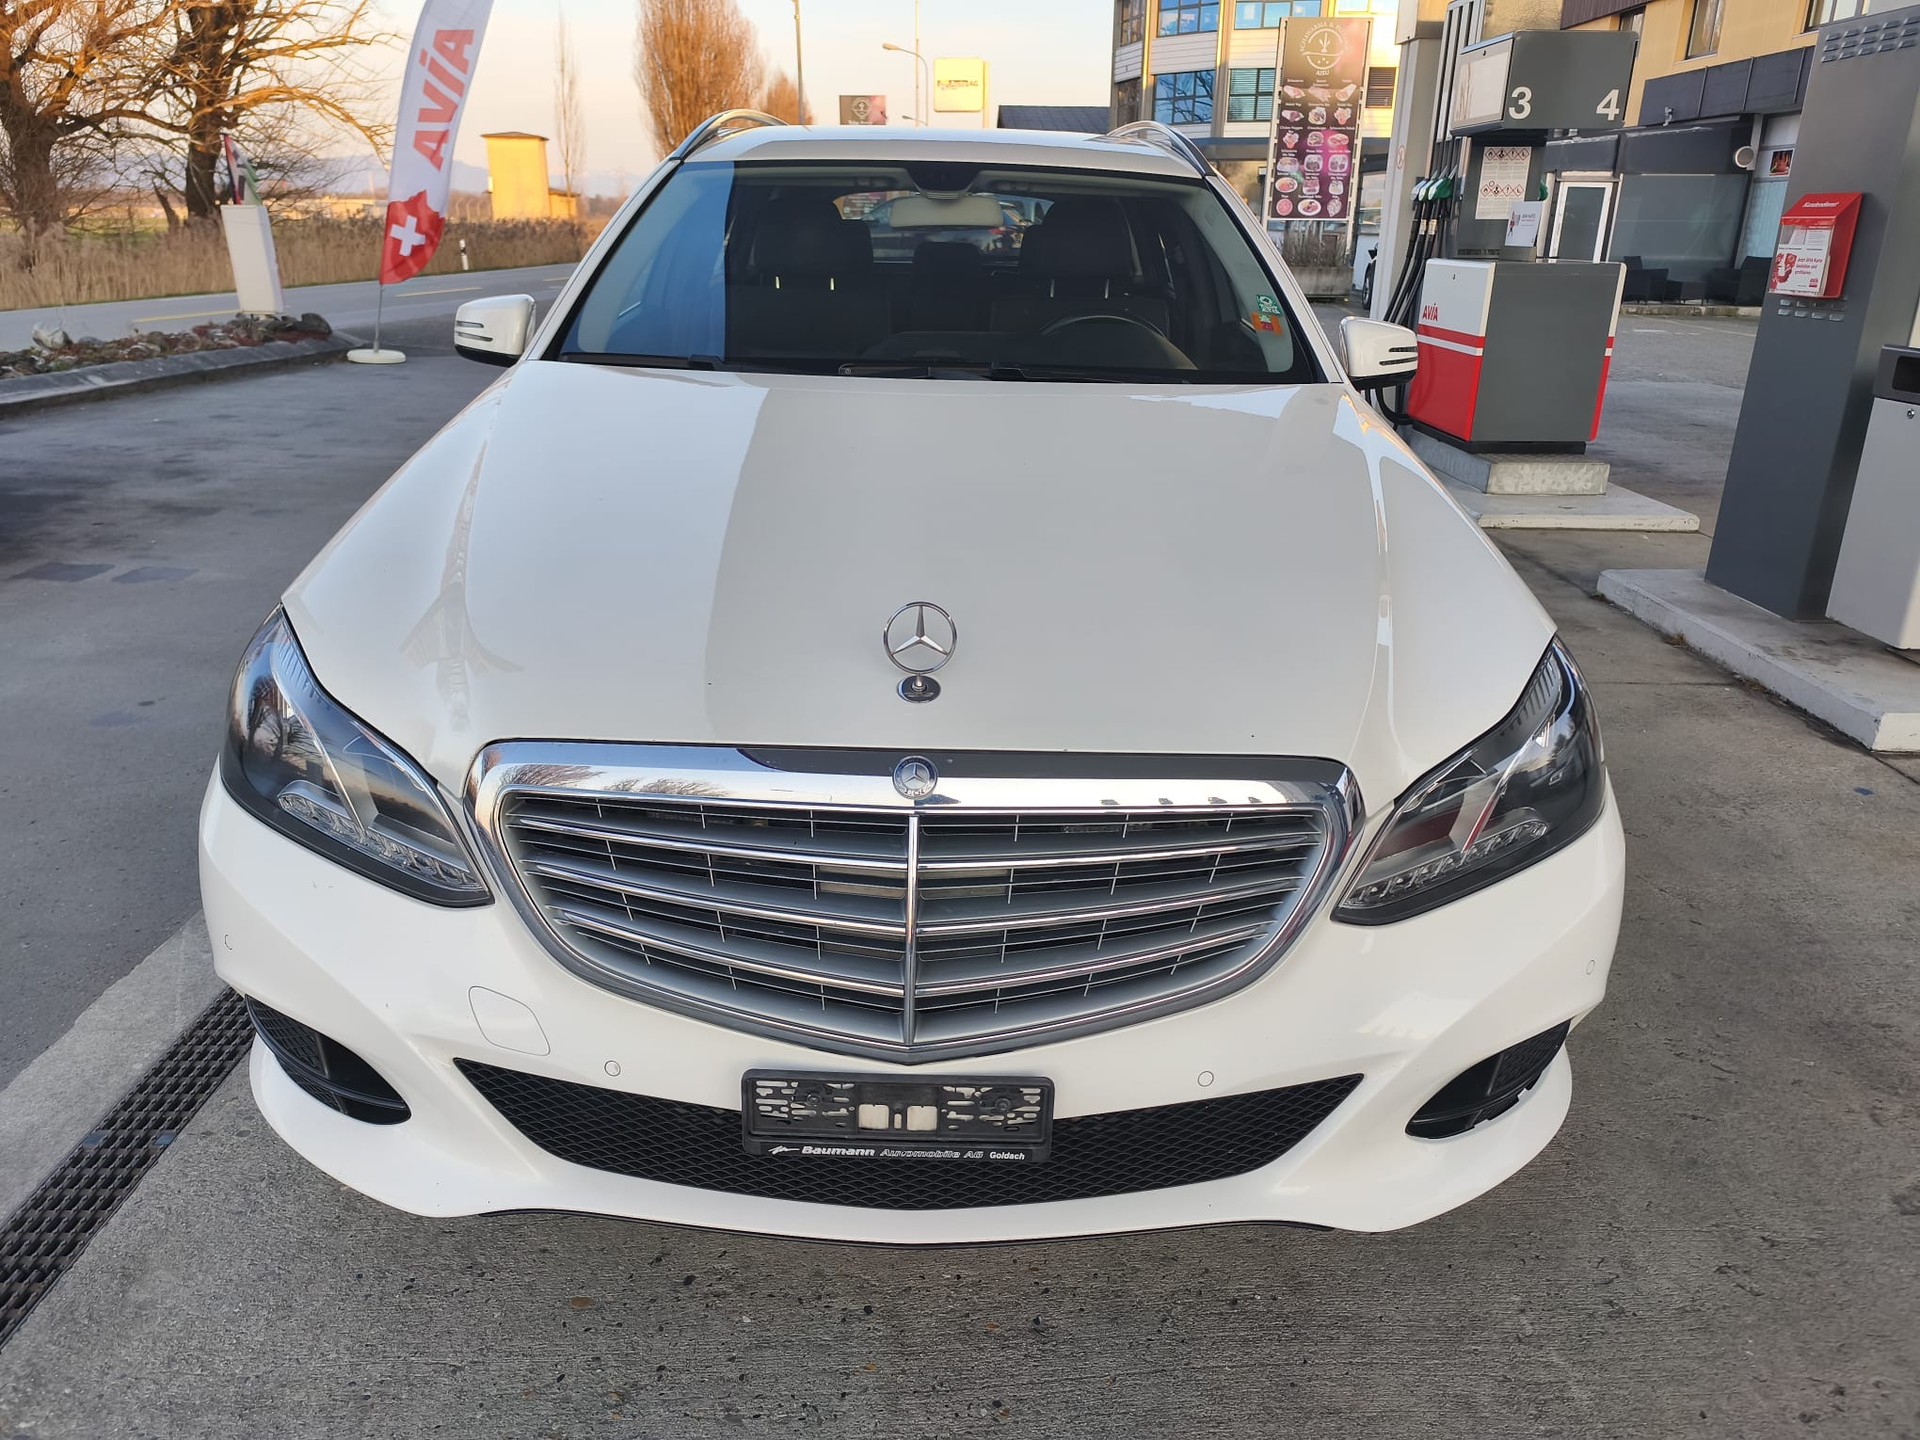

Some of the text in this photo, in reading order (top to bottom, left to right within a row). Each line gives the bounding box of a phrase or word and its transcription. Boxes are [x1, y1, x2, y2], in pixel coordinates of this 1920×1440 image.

[413, 29, 474, 173] AVIA
[1508, 86, 1533, 120] 3
[1595, 88, 1621, 121] 4
[1422, 303, 1438, 322] AVIA
[802, 1146, 876, 1157] Baumann
[879, 1148, 960, 1159] Automobile
[989, 1151, 1025, 1161] Goldach
